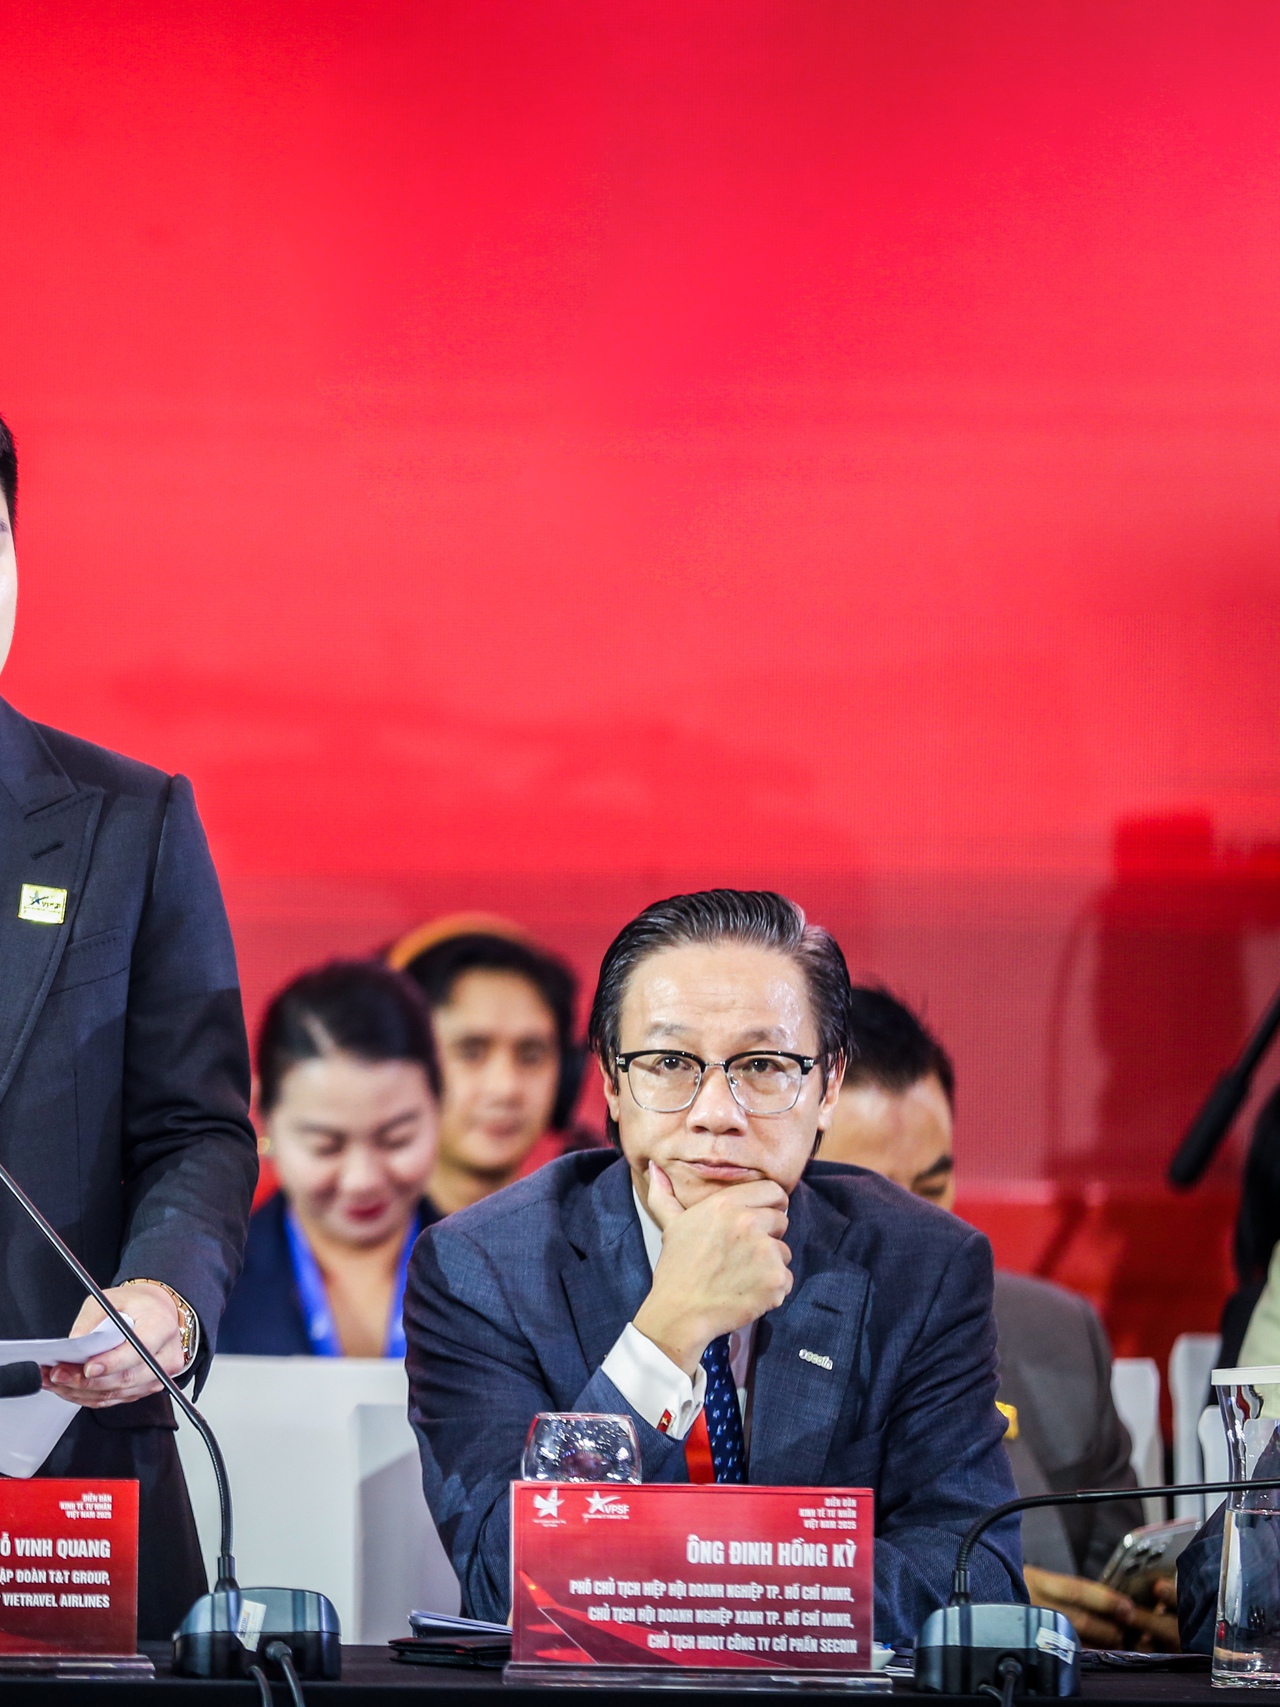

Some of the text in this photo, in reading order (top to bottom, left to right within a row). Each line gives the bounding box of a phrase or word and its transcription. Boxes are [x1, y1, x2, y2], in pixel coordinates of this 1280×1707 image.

[604, 1504, 630, 1514] VPSF
[14, 1538, 53, 1558] VINH
[56, 1538, 111, 1560] QUANG
[686, 1534, 857, 1568] ÔNG ĐINH HỒNG KỲ
[15, 1567, 46, 1584] ĐOÀN
[48, 1570, 70, 1584] T&T
[71, 1570, 110, 1586] GROUP,
[2, 1592, 58, 1608] VIETRAVEL
[60, 1594, 110, 1608] AIRLINES
[569, 1578, 592, 1595] PHÓ
[594, 1576, 616, 1596] CHỦ
[617, 1581, 641, 1598] TỊCH
[642, 1578, 667, 1600] HIỆP
[668, 1580, 687, 1600] HỘI
[688, 1583, 724, 1598] DOANH
[726, 1582, 764, 1602] NGHIỆP
[766, 1585, 783, 1600] TP.
[802, 1584, 820, 1600] CHÍ
[822, 1586, 854, 1602] MINH,
[588, 1602, 610, 1621] CHỦ
[611, 1607, 636, 1624] TỊCH
[636, 1604, 656, 1625] HỘI
[657, 1608, 694, 1623] DOANH
[695, 1606, 734, 1627] NGHIỆP
[734, 1610, 764, 1625] XANH
[766, 1611, 783, 1626] TP.
[802, 1609, 820, 1626] CHÍ
[822, 1612, 854, 1628] MINH,
[647, 1630, 670, 1648] CHỦ
[671, 1634, 696, 1652] TỊCH
[726, 1632, 756, 1651] CÔNG
[757, 1636, 770, 1651] TY
[789, 1635, 818, 1652] PHẦN
[820, 1638, 858, 1654] SECOIN
